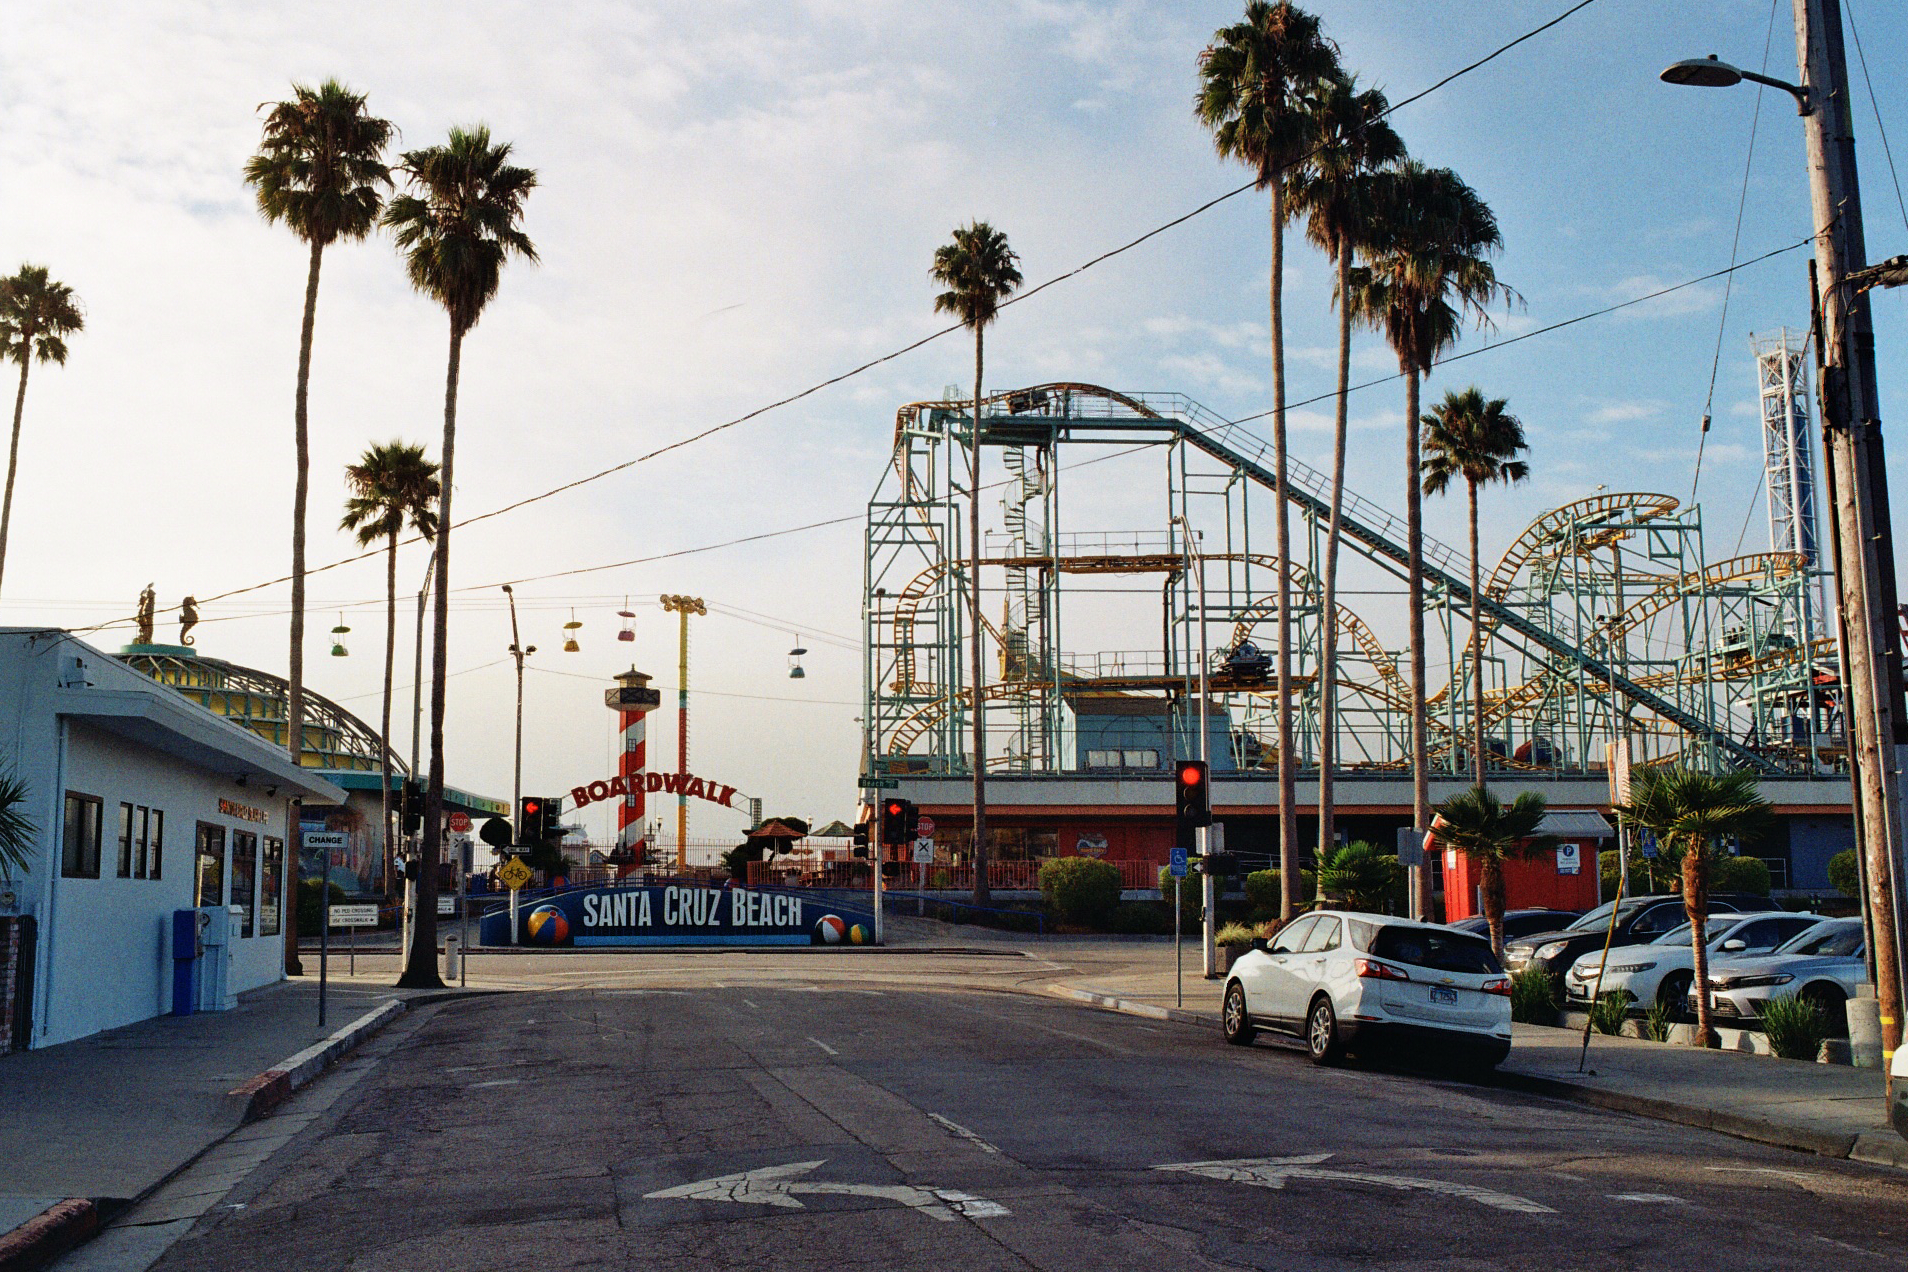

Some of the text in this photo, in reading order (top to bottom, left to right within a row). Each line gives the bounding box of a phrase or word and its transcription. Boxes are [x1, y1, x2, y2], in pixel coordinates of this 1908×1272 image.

[571, 772, 737, 808] BOARDWALK
[451, 818, 468, 826] STOP
[308, 836, 343, 844] CHANGE
[583, 886, 802, 927] SANTA CRUZ BEACH
